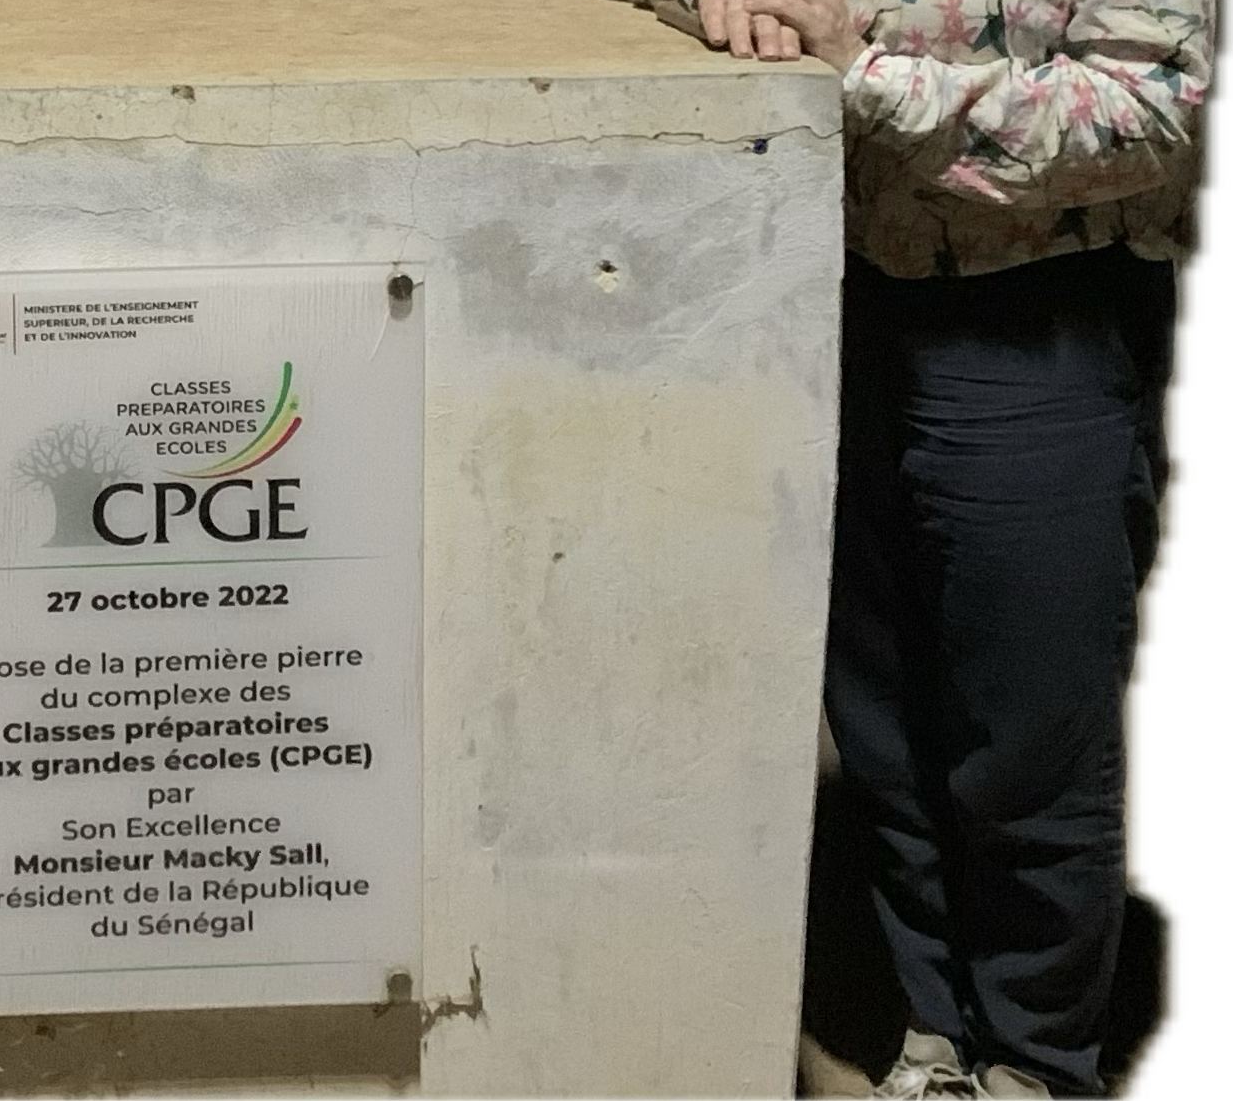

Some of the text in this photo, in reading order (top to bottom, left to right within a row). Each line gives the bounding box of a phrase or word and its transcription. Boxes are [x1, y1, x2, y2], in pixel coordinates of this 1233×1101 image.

[23, 300, 199, 315] MINISTERE DE L'ENSEIGNEMENT
[23, 314, 194, 329] SUPERIEUR, DE LA RECHERCHE
[24, 330, 137, 342] ET DE L'INNOVATION
[151, 381, 230, 396] CLASSES
[117, 399, 265, 416] PREPARATOIRES
[126, 420, 256, 436] AUX GRANDES
[157, 440, 226, 455] ECOLES
[92, 479, 308, 546] CPGE
[47, 585, 288, 612] 27 octobre 2022
[55, 654, 91, 675] de
[102, 653, 123, 674] la
[135, 648, 267, 678] première
[278, 646, 362, 673] pierre
[41, 681, 290, 710] du complexe des
[3, 712, 328, 744] Classes préparatoires
[32, 751, 155, 781] grandes
[164, 748, 260, 770] écoles
[271, 743, 372, 772] (CPGE)
[149, 788, 194, 809] par
[63, 814, 280, 840] Son Excellence
[15, 843, 328, 875] Monsieur Macky Sall,
[124, 882, 158, 903] de
[170, 881, 191, 901] la
[203, 875, 369, 904] République
[91, 910, 253, 937] du Sénégal
